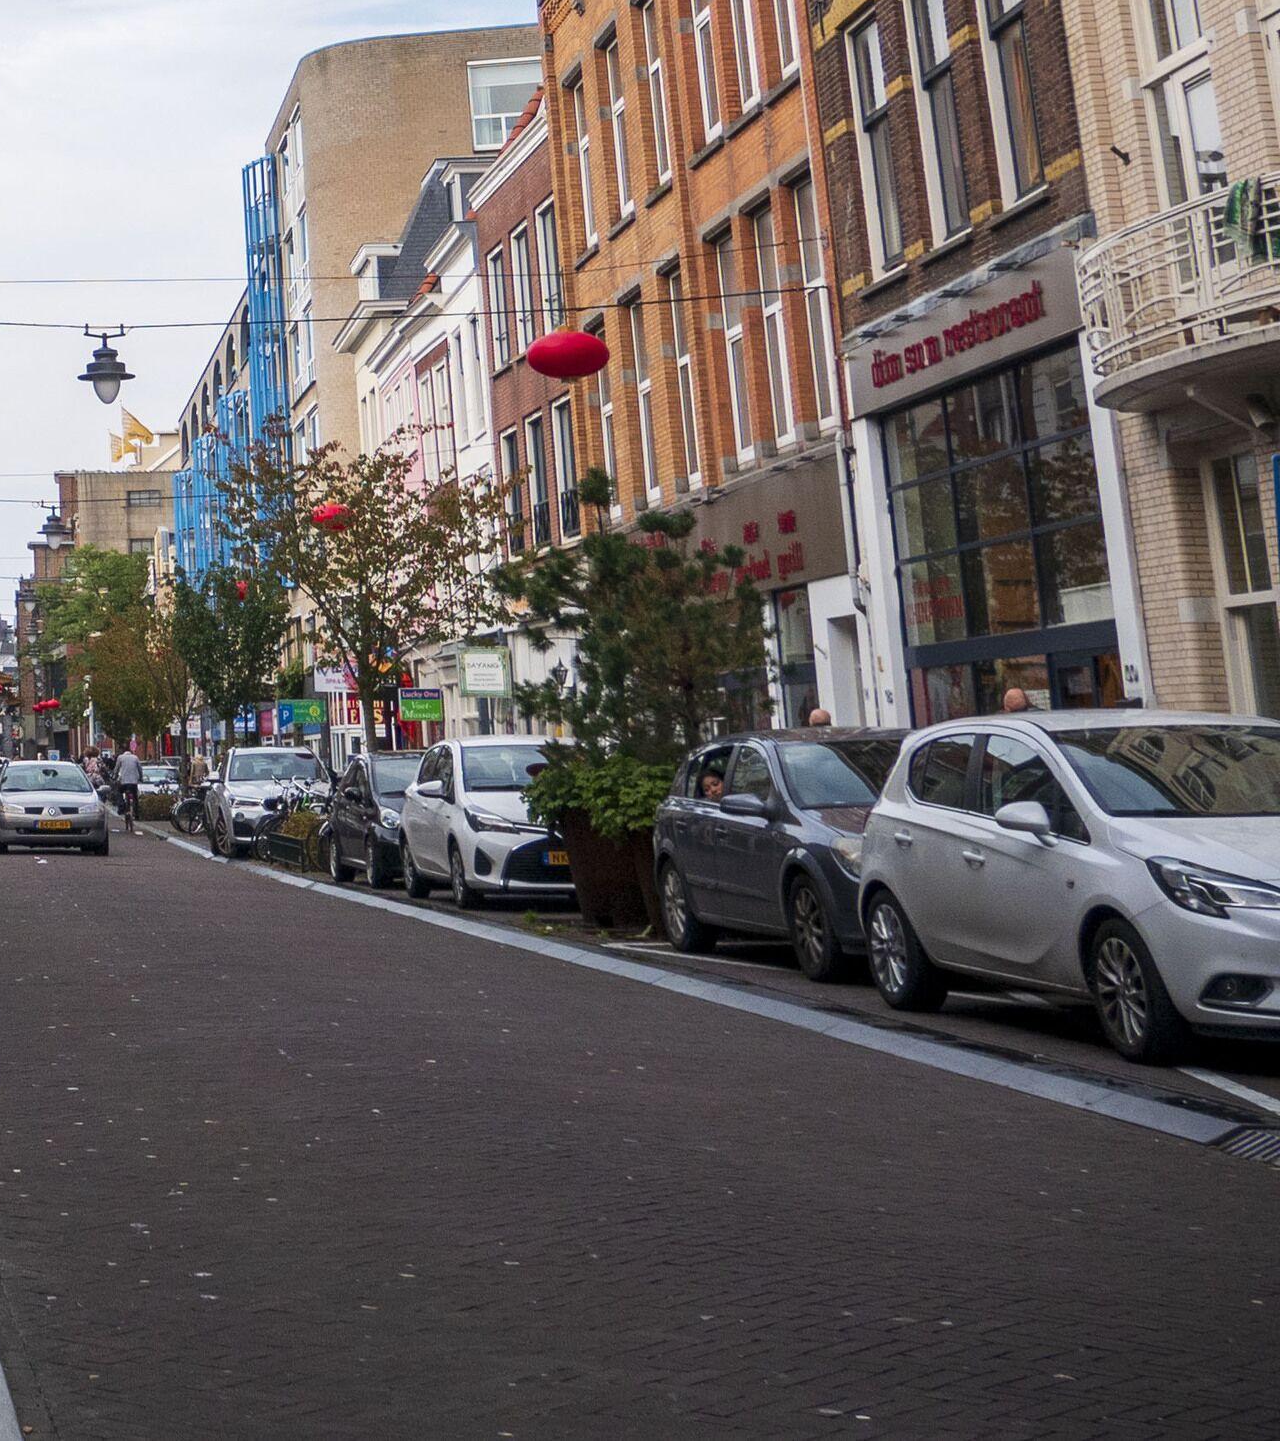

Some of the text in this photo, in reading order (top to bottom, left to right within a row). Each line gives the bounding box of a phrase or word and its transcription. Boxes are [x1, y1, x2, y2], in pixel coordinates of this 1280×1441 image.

[942, 280, 1046, 357] restaurant
[402, 690, 422, 699] Lucky
[282, 710, 290, 720] P
[404, 710, 440, 720] Massage
